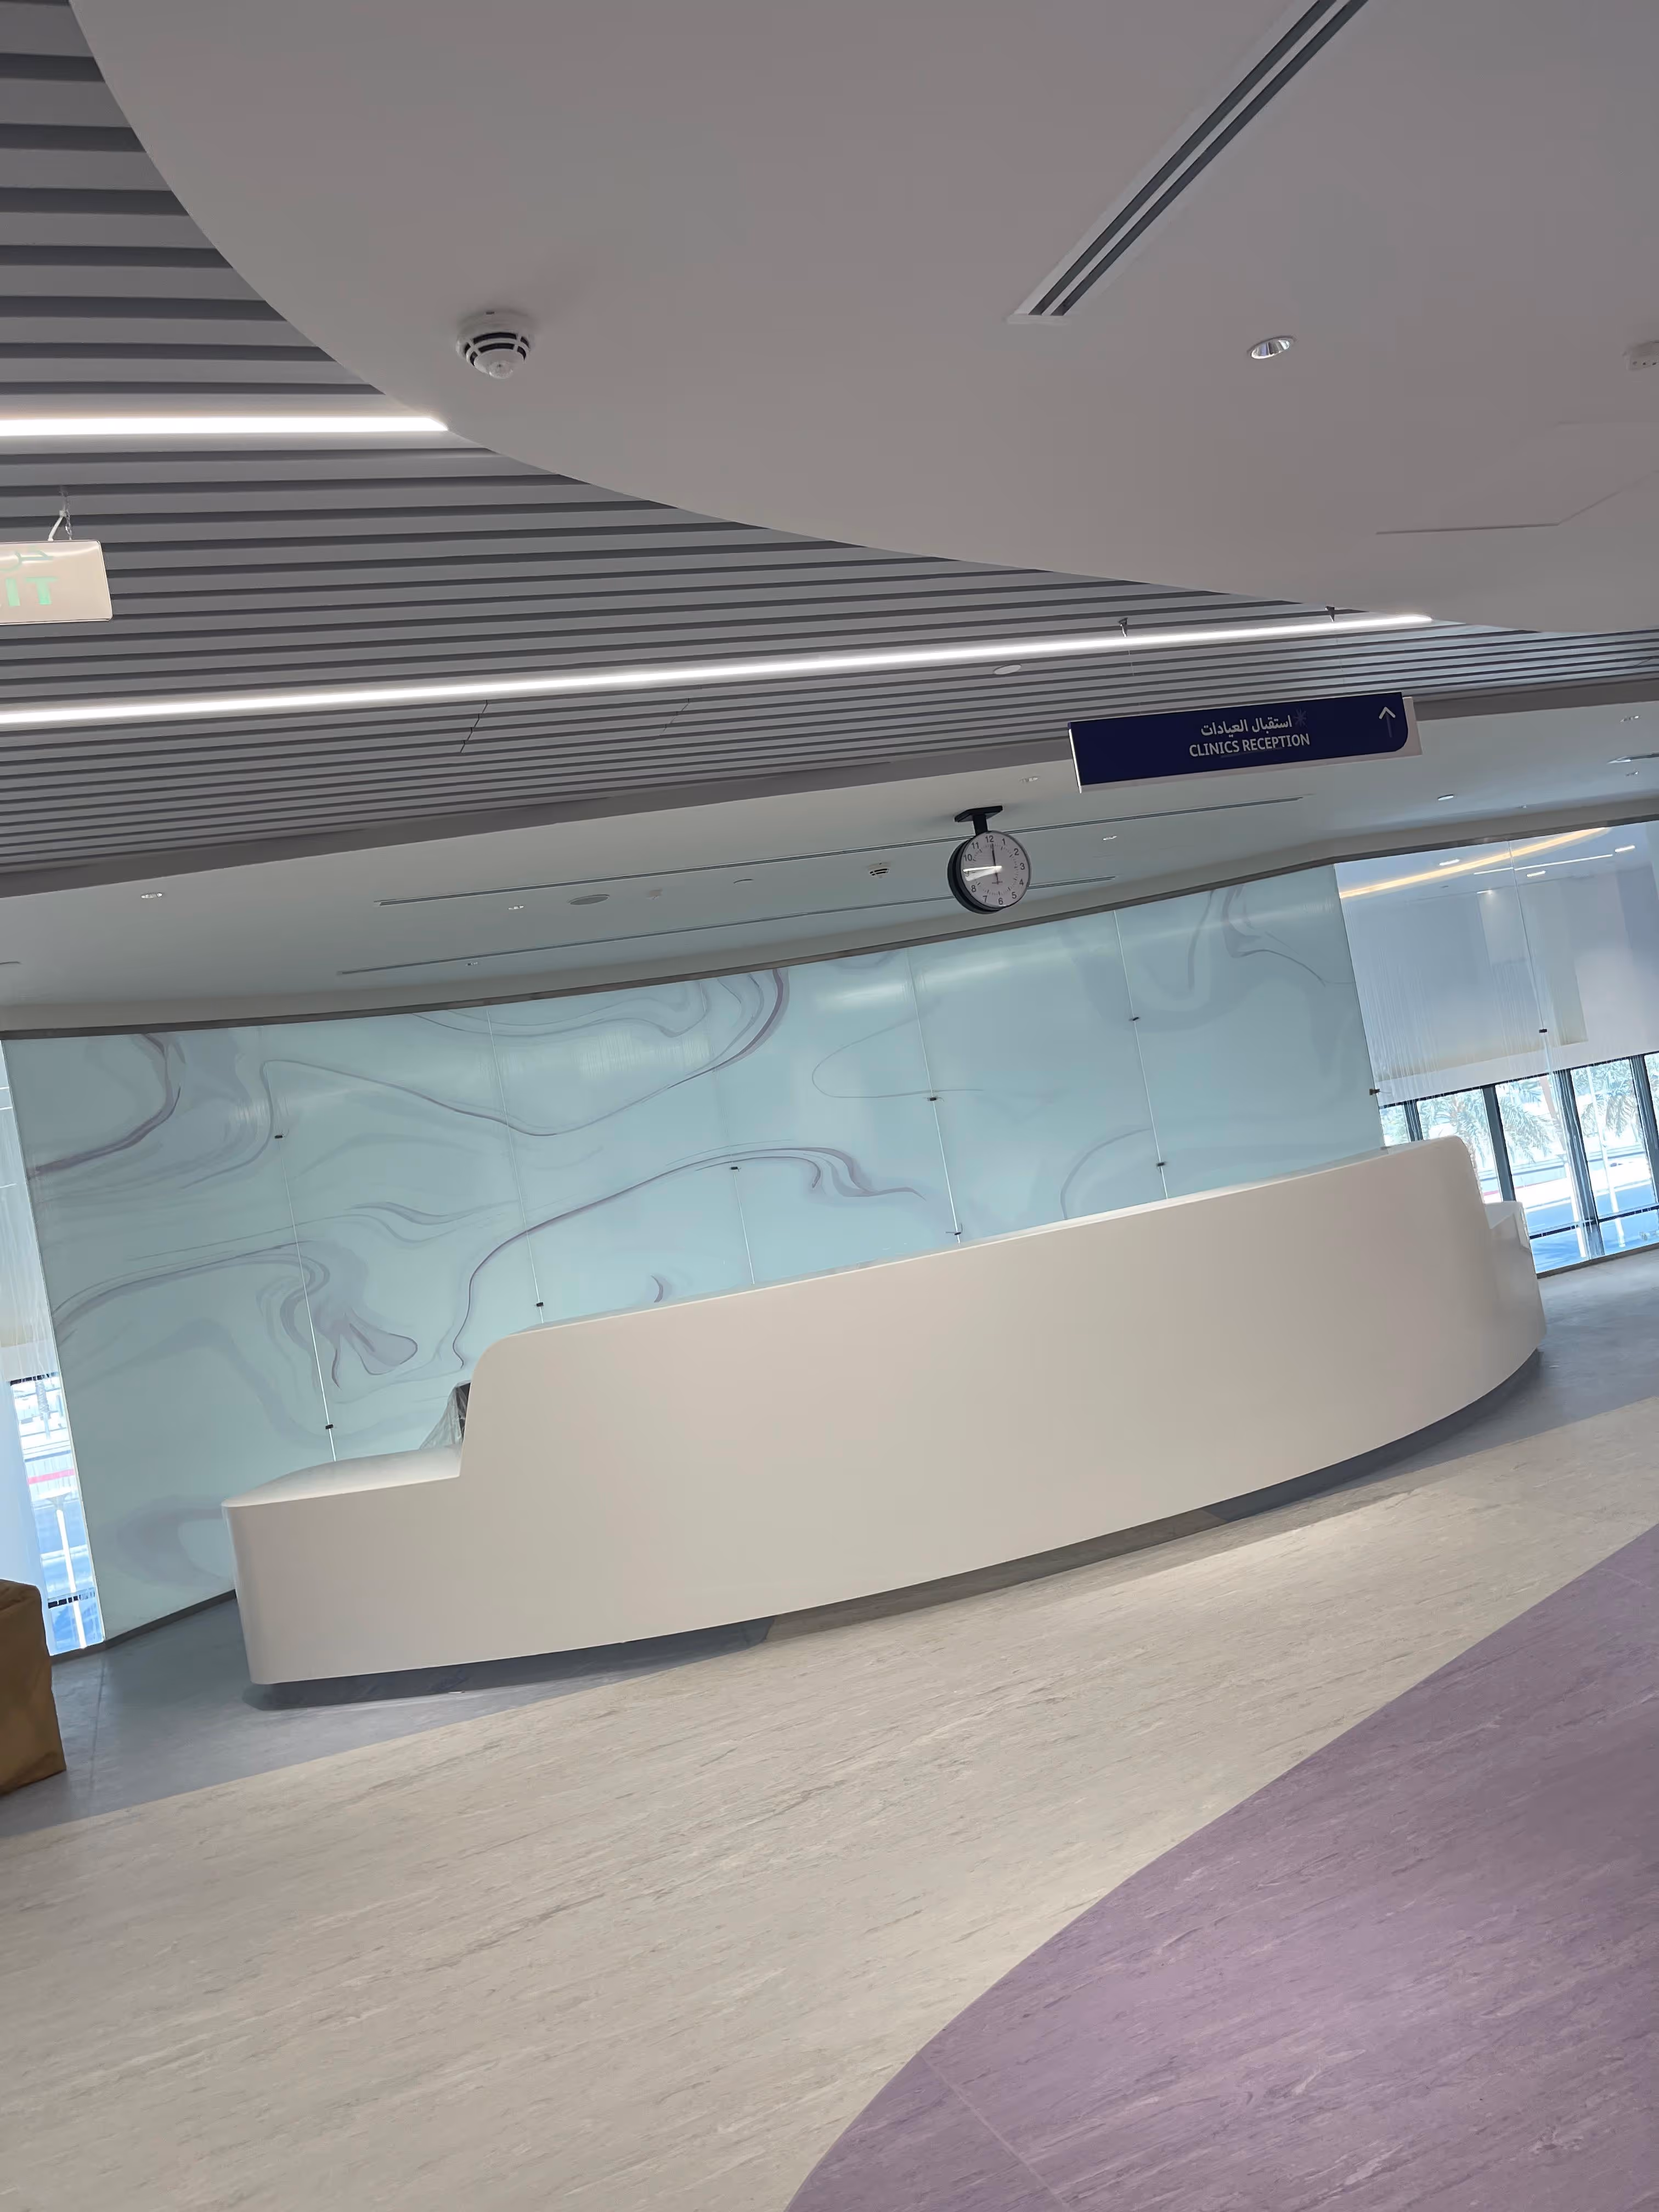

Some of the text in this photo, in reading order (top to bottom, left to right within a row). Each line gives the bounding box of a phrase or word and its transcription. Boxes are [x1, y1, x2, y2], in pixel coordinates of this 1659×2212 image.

[0, 576, 59, 607] IT
[1200, 715, 1293, 737] استقبال العيادات
[1189, 733, 1311, 758] CLINICS RECEPTION
[985, 835, 995, 843] 12
[971, 842, 980, 850] 11
[1013, 848, 1020, 856] 2
[970, 884, 977, 893] 8
[983, 895, 988, 903] 7
[998, 897, 1003, 905] 6
